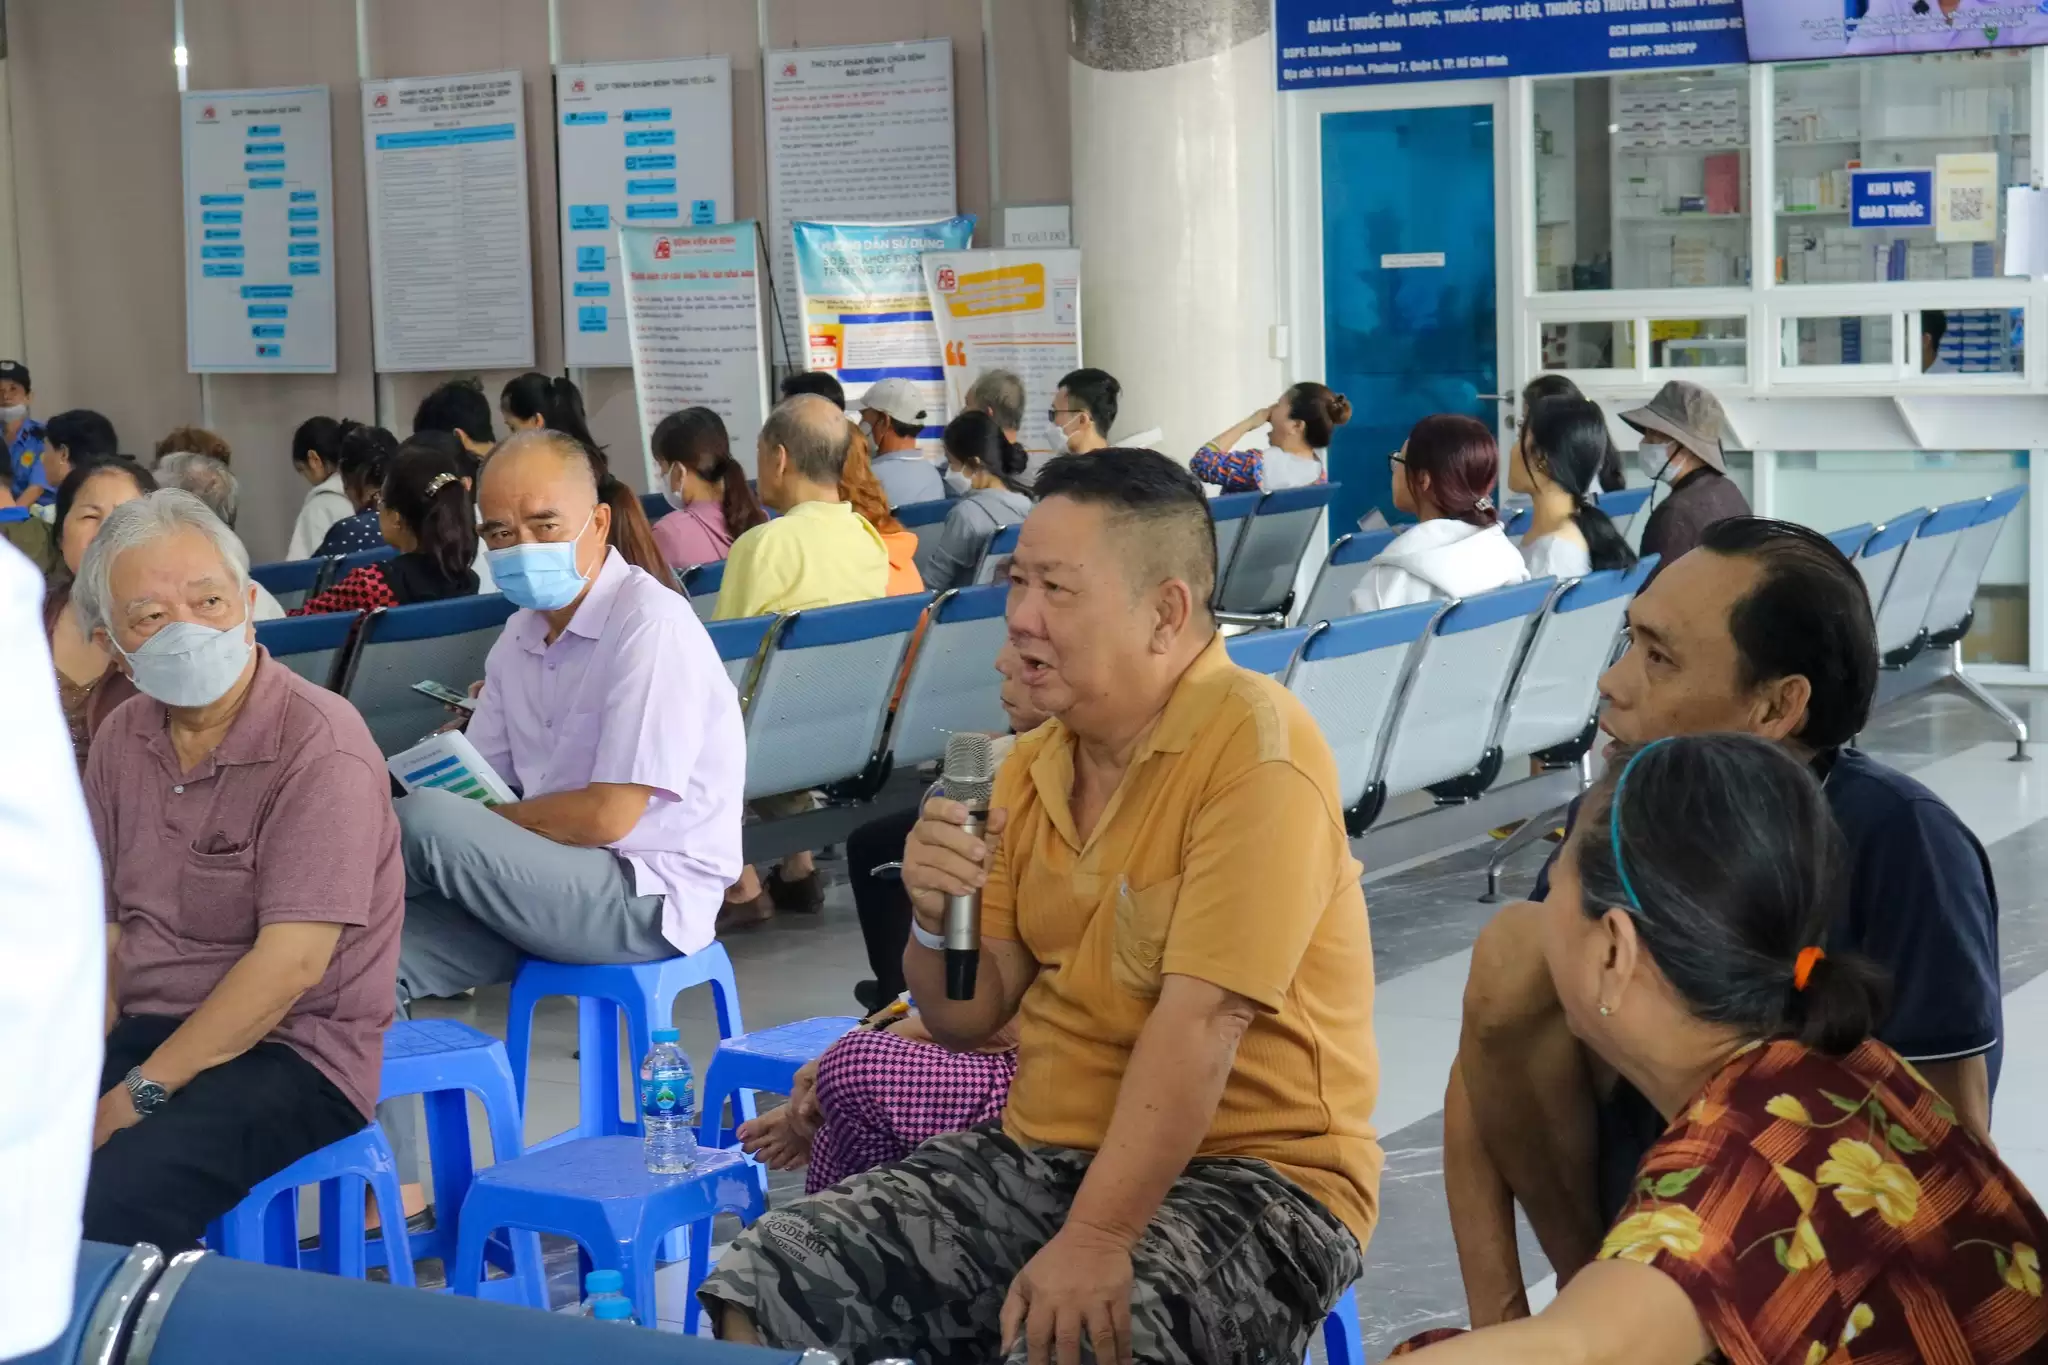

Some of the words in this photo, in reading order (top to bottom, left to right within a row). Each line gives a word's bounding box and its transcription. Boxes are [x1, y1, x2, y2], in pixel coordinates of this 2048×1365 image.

[1308, 17, 1331, 33] BÁN
[1348, 12, 1383, 30] THUỐC
[1444, 4, 1480, 24] THUỐC
[1868, 182, 1891, 196] KHU
[1892, 180, 1916, 197] VỰC
[1859, 205, 1885, 219] GIAO
[1887, 200, 1924, 218] THUỐC
[910, 238, 945, 252] DỤNG
[764, 1220, 827, 1257] GOSDENIM
